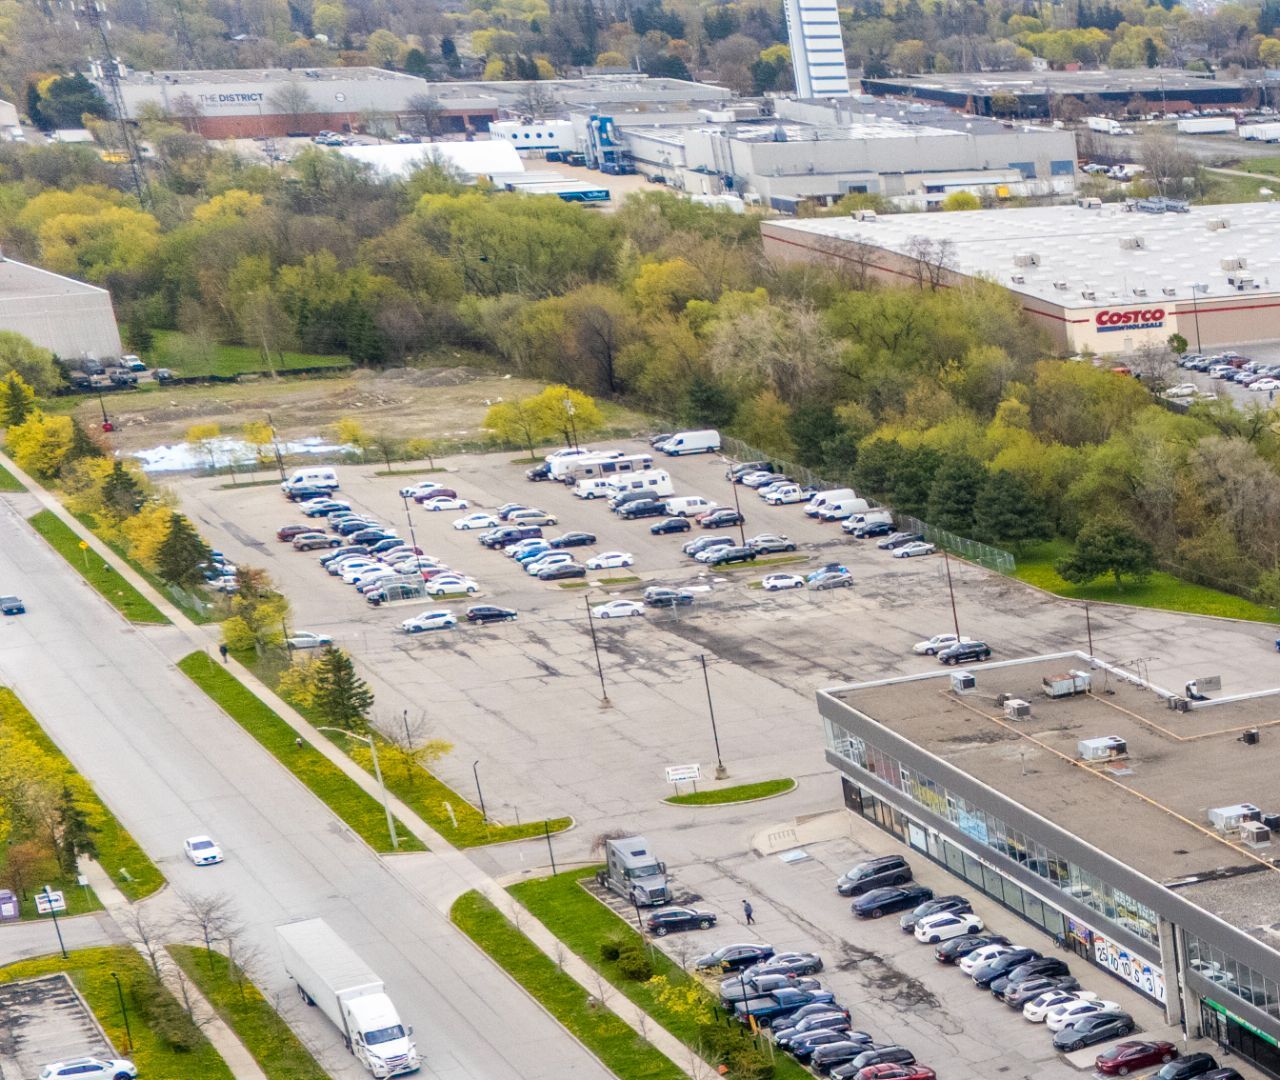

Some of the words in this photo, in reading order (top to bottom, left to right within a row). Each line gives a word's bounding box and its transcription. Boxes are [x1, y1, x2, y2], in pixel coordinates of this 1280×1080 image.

[218, 92, 263, 102] DISTRICT
[1095, 309, 1165, 326] COSTCO
[1097, 947, 1108, 962] 25
[1110, 954, 1119, 972] 10
[1121, 961, 1132, 977] 10
[1134, 970, 1140, 983] 5
[1146, 977, 1153, 992] 3
